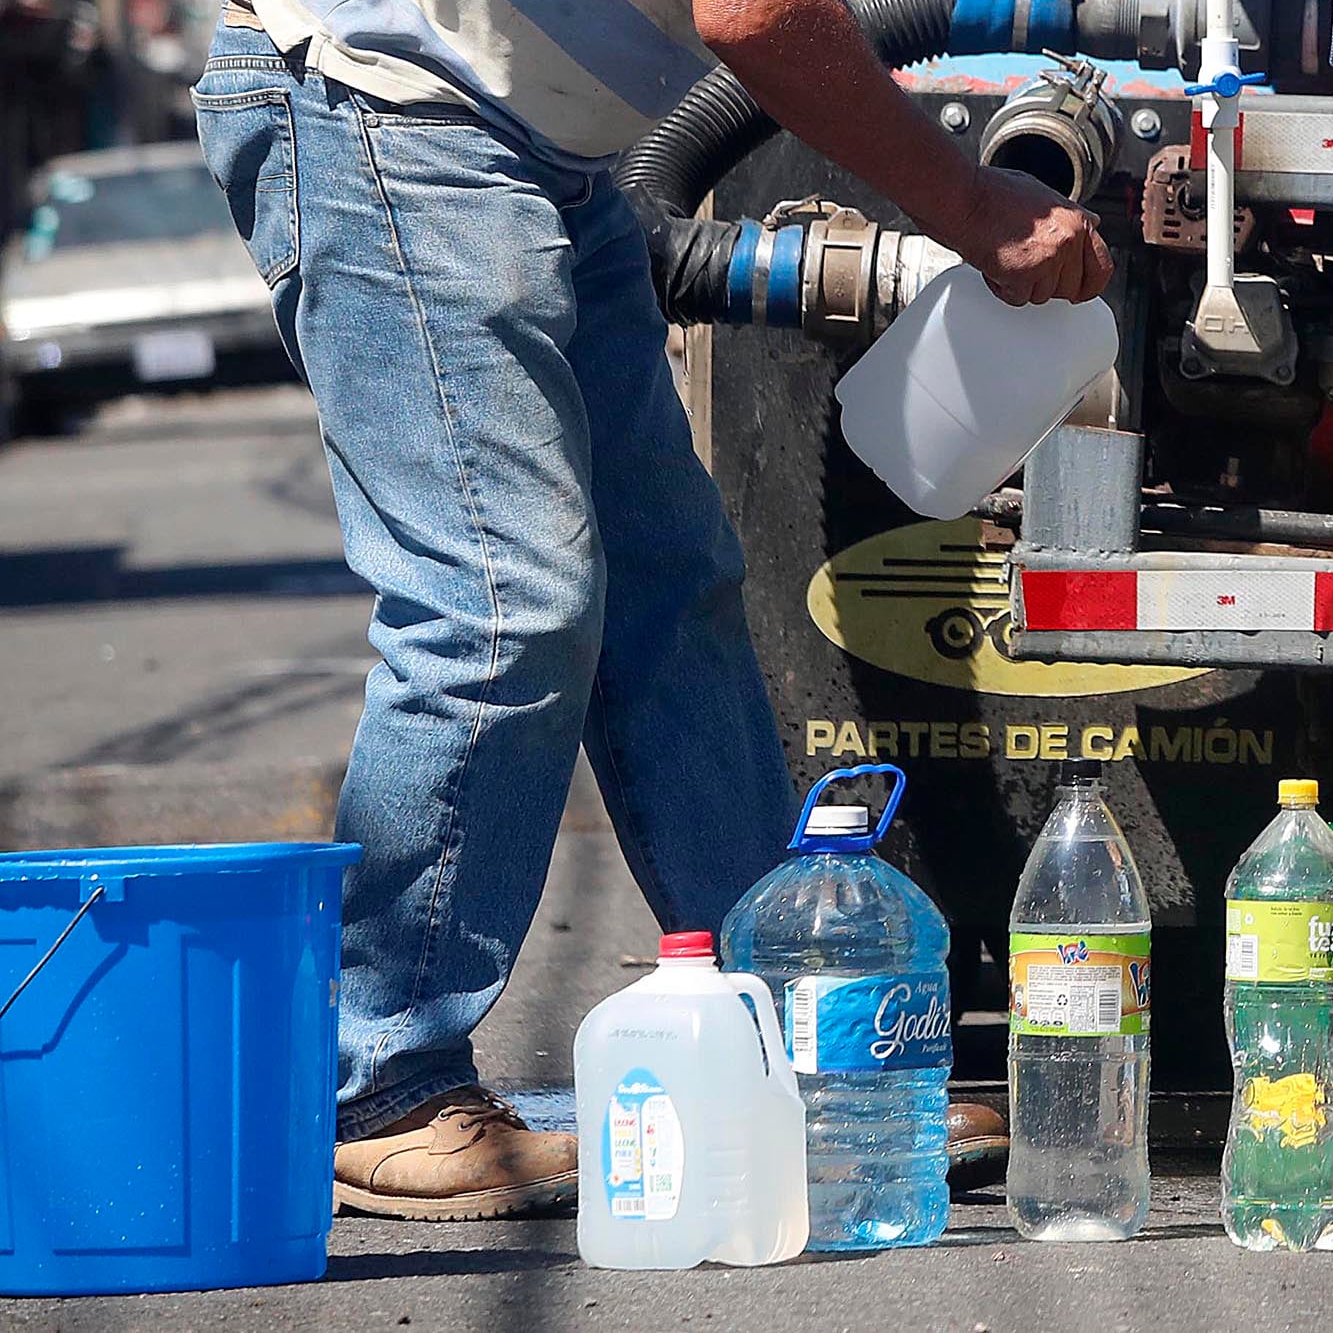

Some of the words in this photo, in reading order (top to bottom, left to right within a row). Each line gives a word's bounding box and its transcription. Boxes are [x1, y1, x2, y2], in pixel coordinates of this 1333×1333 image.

[1216, 595, 1237, 607] 3M
[806, 719, 990, 759] PARTES
[1005, 724, 1070, 762] DE
[1081, 718, 1274, 765] CAMIÓN
